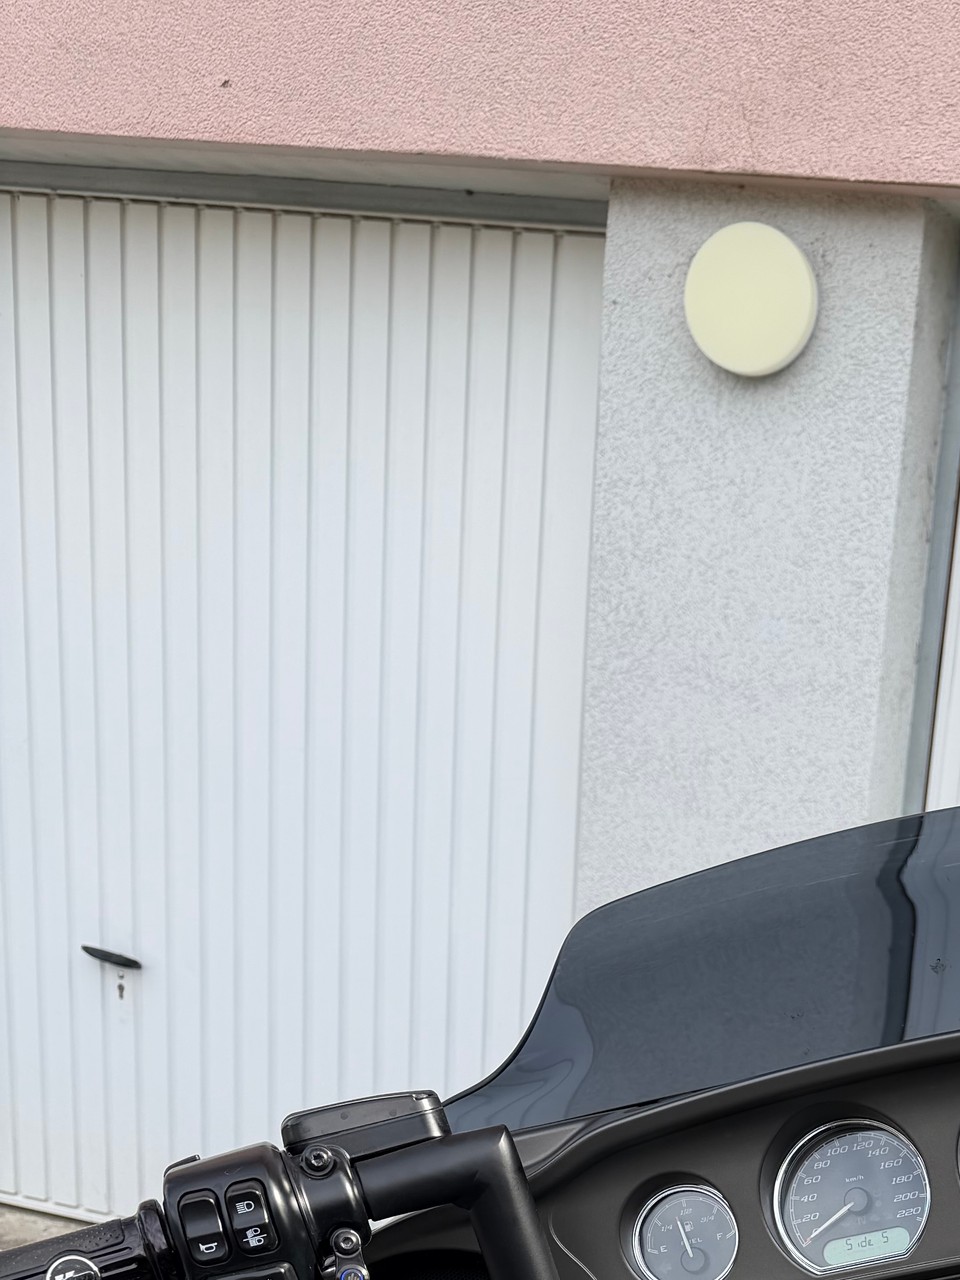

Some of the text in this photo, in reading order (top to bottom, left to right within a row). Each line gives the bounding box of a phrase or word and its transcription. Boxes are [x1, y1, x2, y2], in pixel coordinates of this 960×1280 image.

[852, 1140, 874, 1151] 120
[826, 1145, 849, 1157] 100
[867, 1146, 889, 1157] 140
[813, 1160, 831, 1170] 80
[879, 1159, 902, 1170] 160
[804, 1175, 821, 1185] 60
[845, 1174, 864, 1183] km/h
[891, 1174, 913, 1185] 180
[800, 1193, 818, 1203] 40
[893, 1191, 918, 1202] 200
[802, 1212, 820, 1222] 20
[896, 1206, 921, 1218] 220
[716, 1232, 723, 1240] F
[660, 1245, 668, 1253] E
